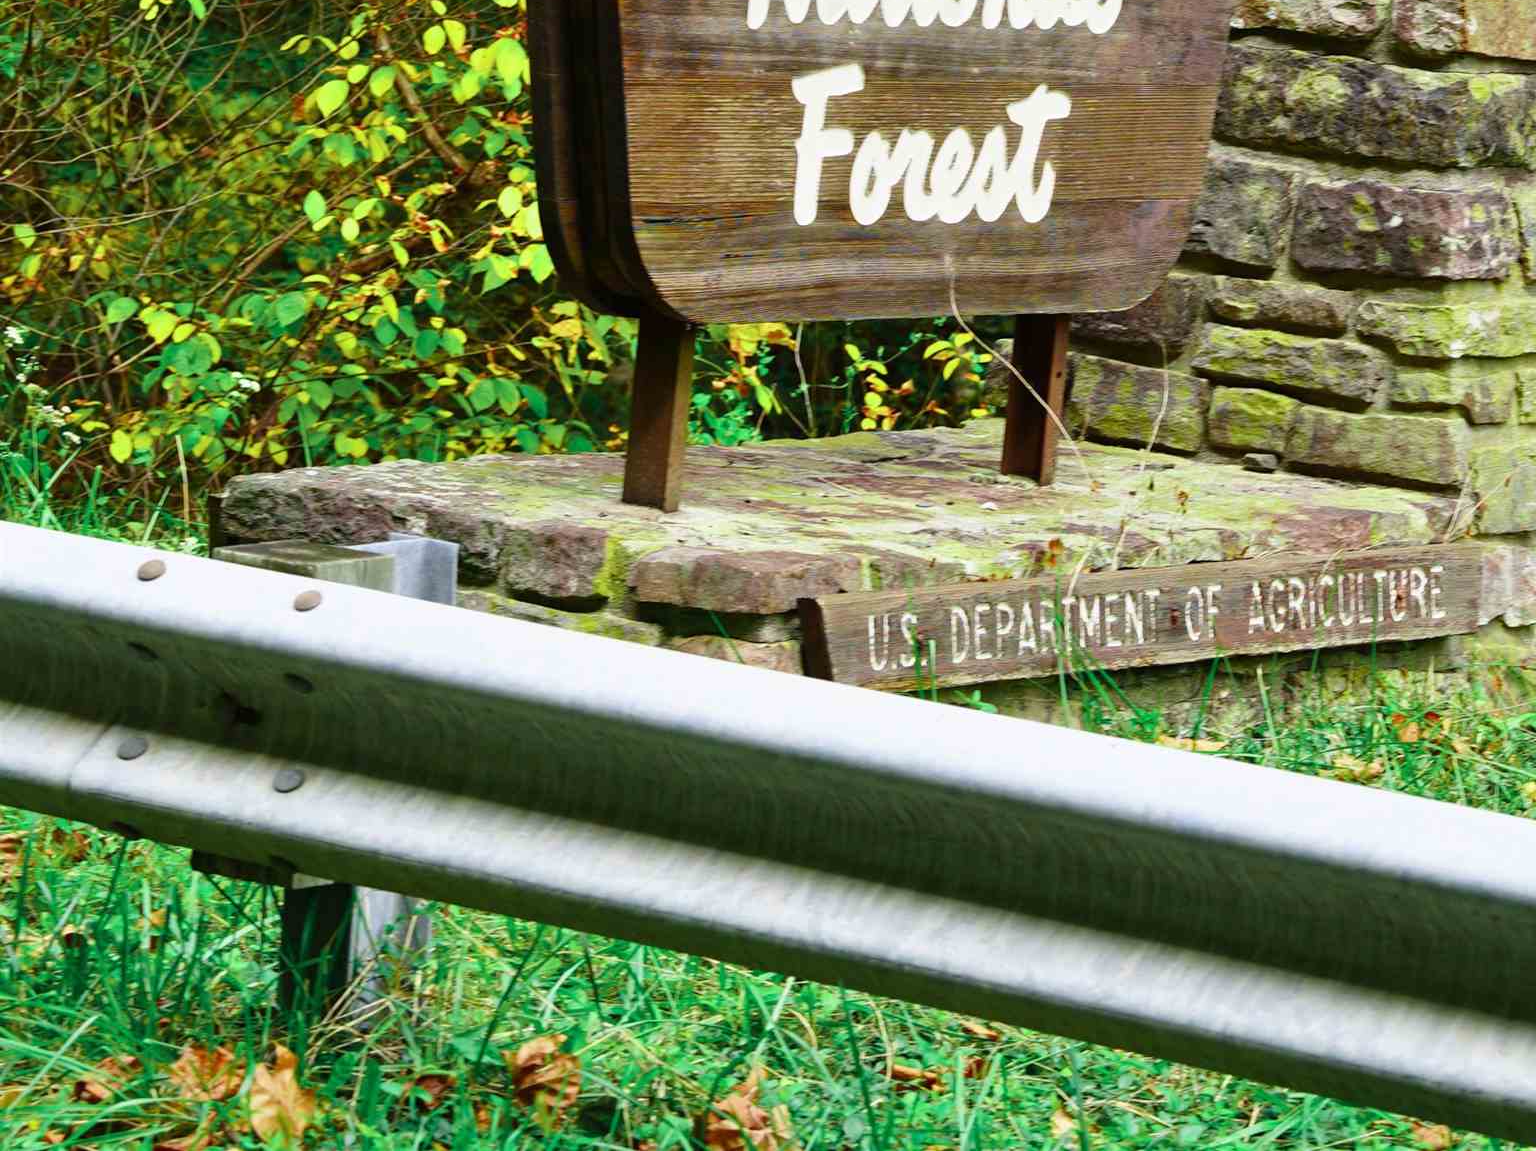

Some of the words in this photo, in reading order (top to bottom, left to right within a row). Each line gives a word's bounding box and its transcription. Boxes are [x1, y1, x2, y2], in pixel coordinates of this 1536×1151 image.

[791, 63, 1072, 226] Forest
[867, 614, 928, 672] U.S.
[950, 588, 1161, 665] DEPARTMENT
[1185, 584, 1222, 642] OF
[1247, 565, 1447, 635] AGRICULTURE
